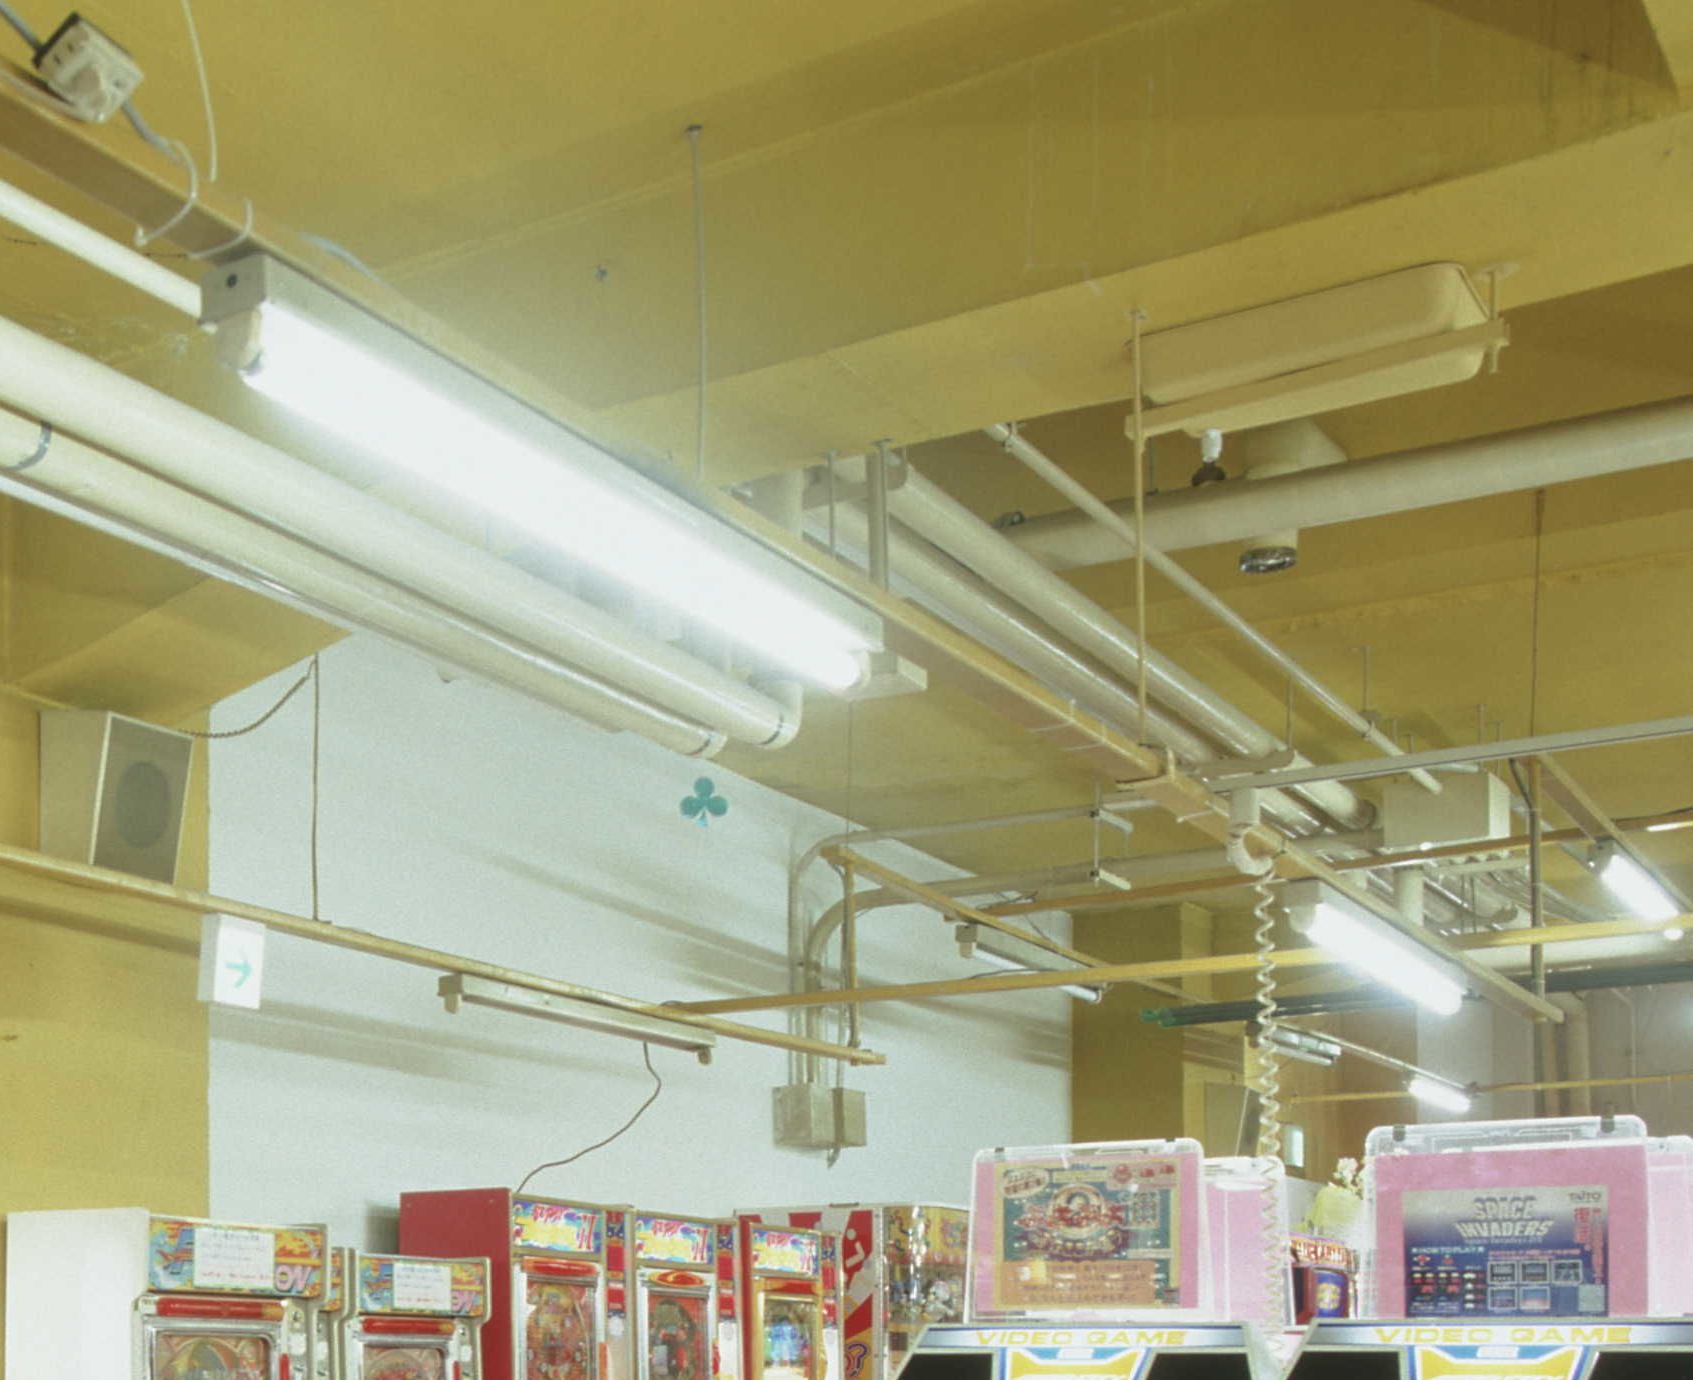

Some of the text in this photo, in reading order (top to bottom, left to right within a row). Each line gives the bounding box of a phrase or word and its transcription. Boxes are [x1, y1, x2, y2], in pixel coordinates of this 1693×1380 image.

[1474, 1196, 1537, 1219] SPACE
[1456, 1219, 1554, 1238] INVADERS
[977, 1330, 1187, 1346] VIDEO GAME
[1375, 1327, 1632, 1344] VIDEO GAME
